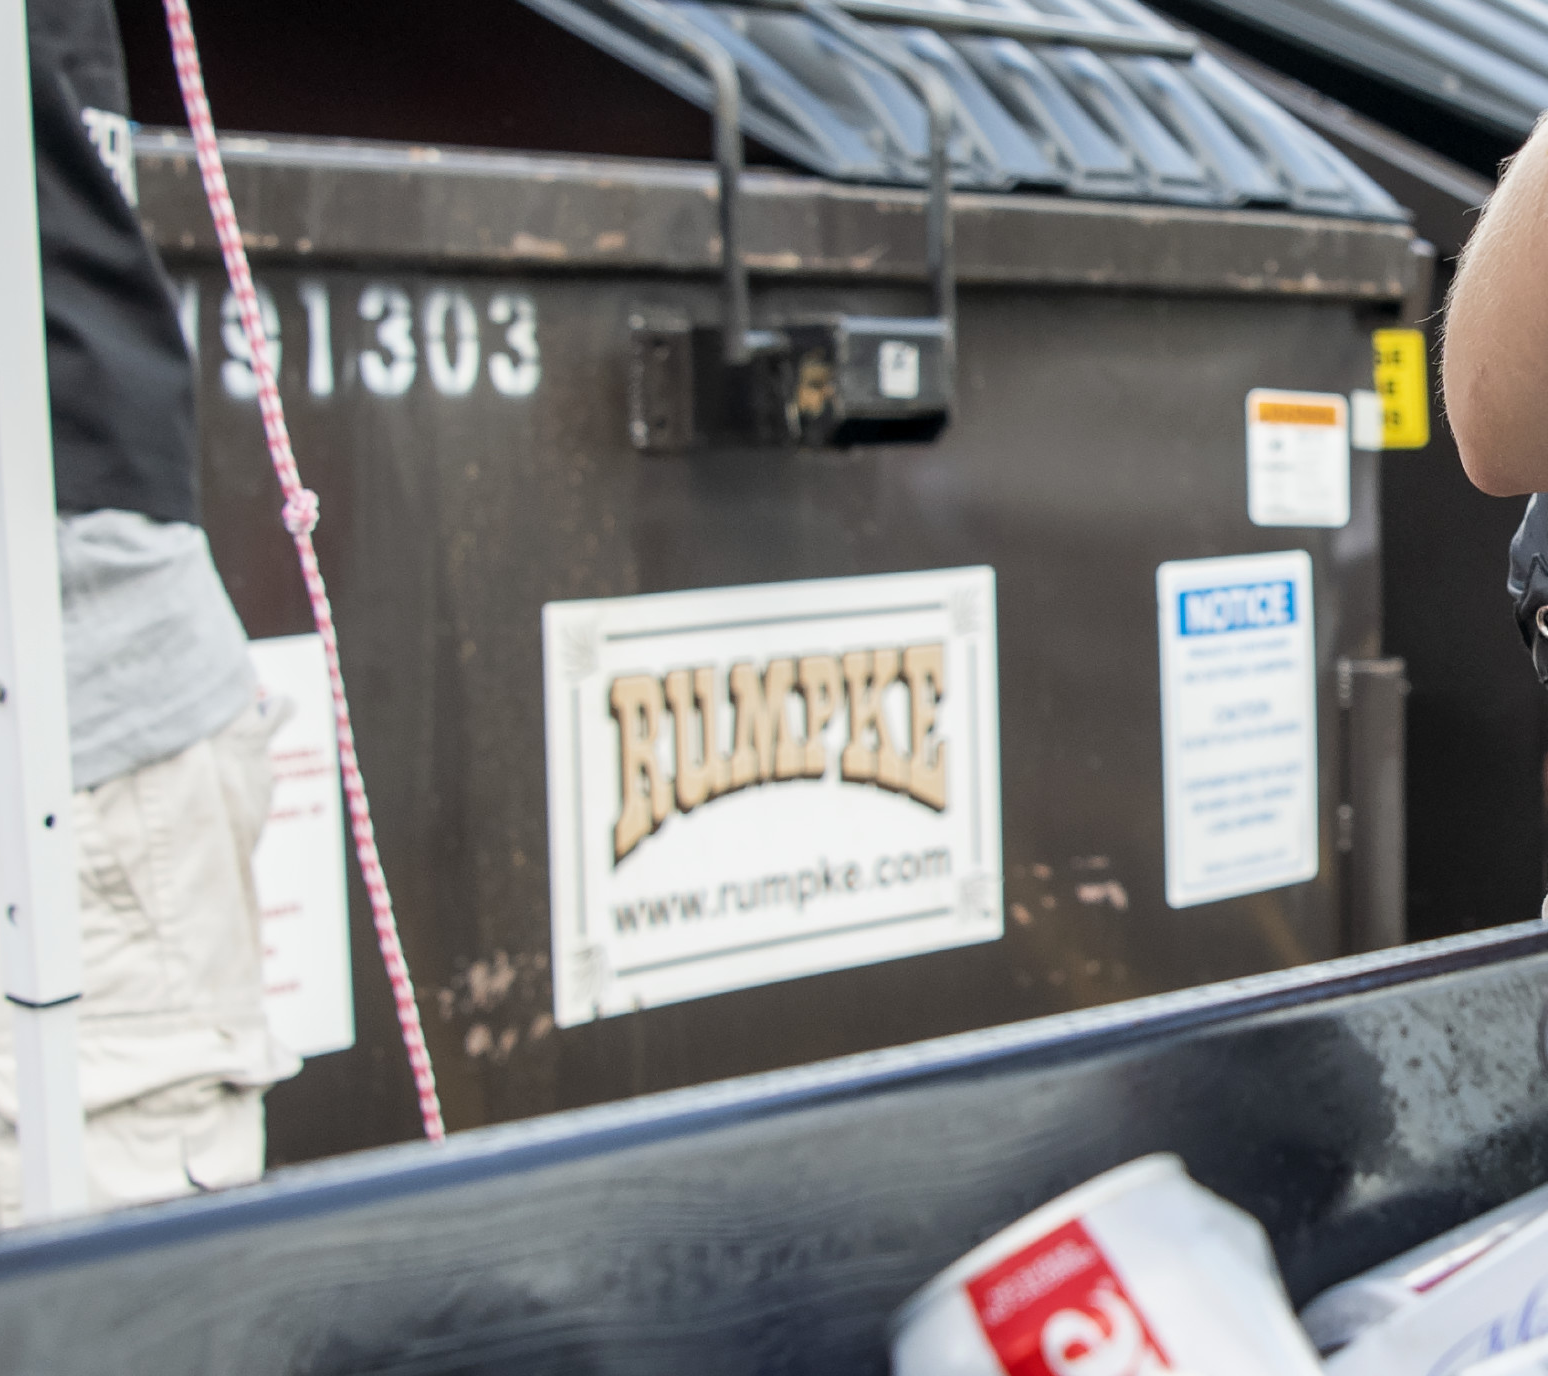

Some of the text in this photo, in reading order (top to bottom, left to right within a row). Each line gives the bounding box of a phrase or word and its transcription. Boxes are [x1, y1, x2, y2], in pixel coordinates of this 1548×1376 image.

[1185, 582, 1291, 633] NOTICE
[608, 642, 949, 870] RUMPKE
[609, 844, 953, 933] www.rumpke.com
